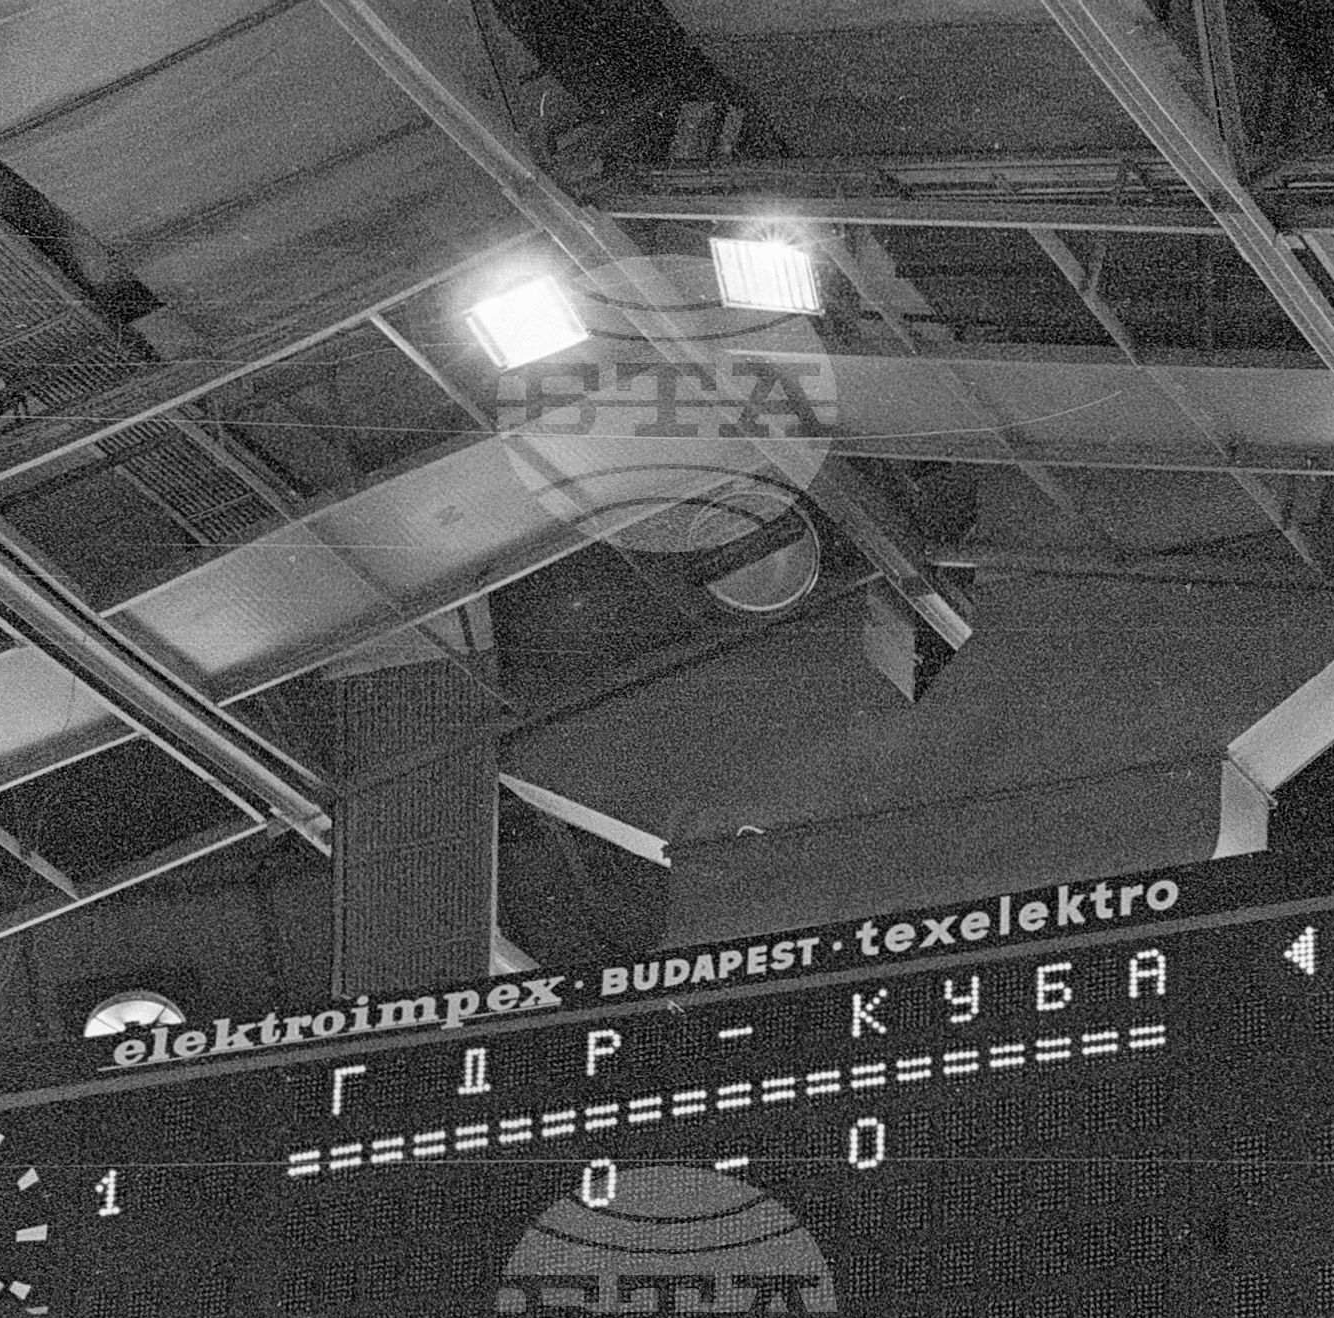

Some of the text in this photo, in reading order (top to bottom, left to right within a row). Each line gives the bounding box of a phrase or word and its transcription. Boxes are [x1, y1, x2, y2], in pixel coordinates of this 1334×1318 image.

[113, 879, 1179, 1067] elektroimpex BUDAPEST texelektro
[94, 1169, 121, 1217] 1
[581, 1157, 618, 1209] 0
[847, 1116, 886, 1170] 0
